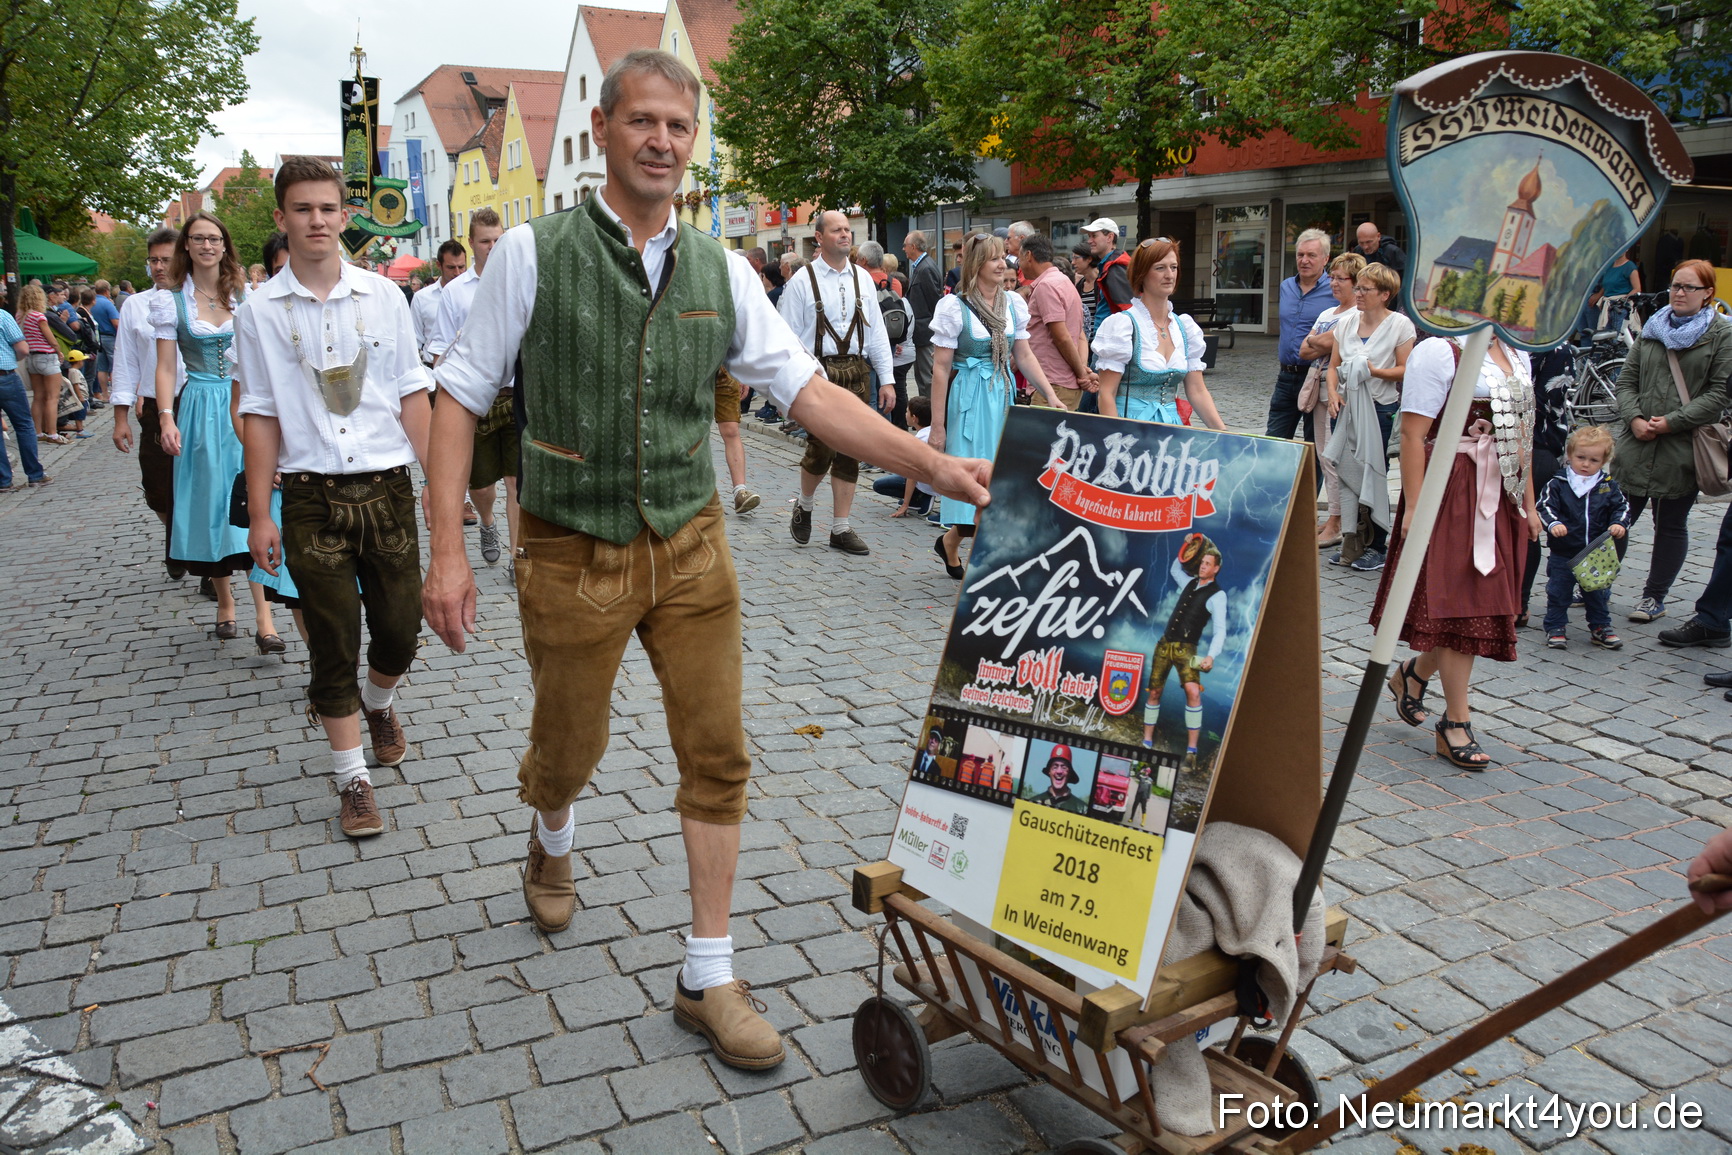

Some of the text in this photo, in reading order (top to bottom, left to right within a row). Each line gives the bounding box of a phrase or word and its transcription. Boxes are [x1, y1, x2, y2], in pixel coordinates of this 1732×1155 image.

[1227, 138, 1291, 168] JOSEF
[1491, 97, 1647, 210] Weidenwang
[411, 172, 420, 194] K&L
[1042, 419, 1220, 501] Da Bobbe
[1074, 490, 1162, 522] bayerisches Kabarett
[1106, 660, 1141, 670] FEUERWEHR
[1107, 653, 1142, 664] FREIWILLIGE
[977, 659, 1015, 683] immer
[1061, 672, 1097, 698] dabei
[961, 685, 989, 703] seines
[990, 689, 1033, 712] zeichens:
[1103, 695, 1131, 710] FACKLBERG
[897, 828, 928, 852] Müller
[1019, 810, 1153, 862] Gauschützenfest
[1053, 853, 1100, 884] 2018
[1040, 888, 1098, 919] am 7.9.
[1003, 904, 1129, 967] In Weidenwang
